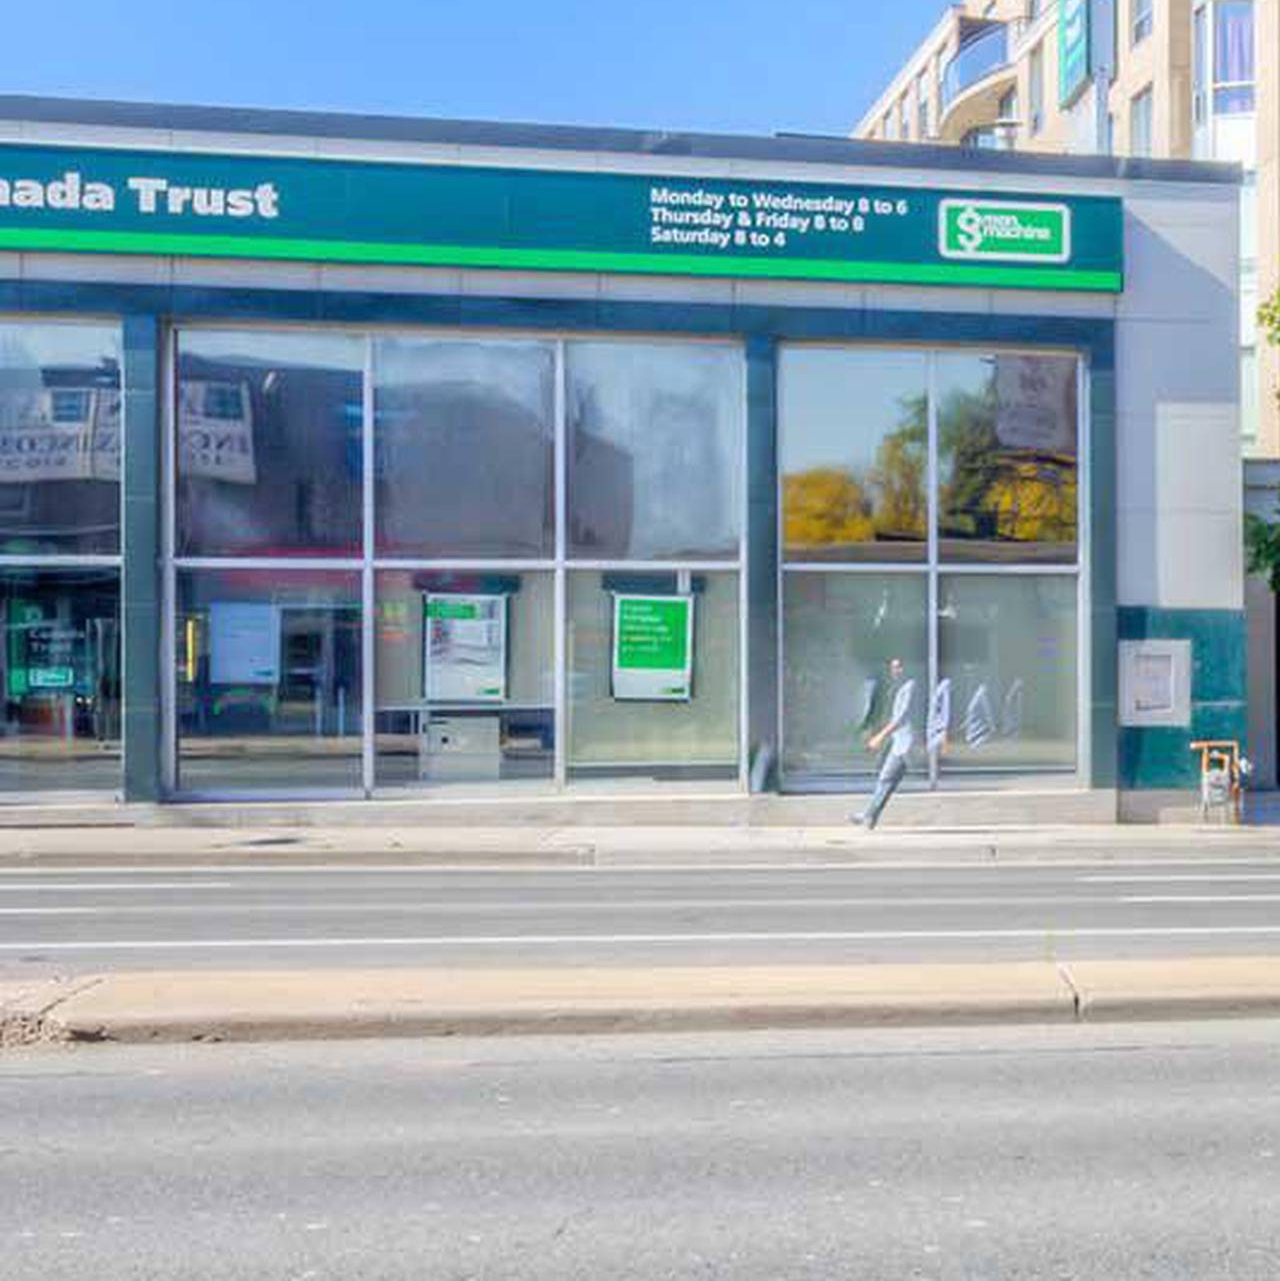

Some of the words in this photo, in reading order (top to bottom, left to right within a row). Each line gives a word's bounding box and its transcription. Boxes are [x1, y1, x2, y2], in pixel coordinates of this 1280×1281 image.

[128, 177, 279, 217] Trust
[651, 188, 724, 210] Monday
[728, 193, 748, 207] to
[752, 192, 854, 216] Wednesday
[873, 199, 893, 214] to
[896, 199, 908, 215] 6
[651, 207, 734, 230] Thursday
[737, 210, 752, 226] &
[755, 211, 811, 233] Friday
[829, 216, 850, 231] to
[651, 226, 731, 248] Saturday
[749, 232, 769, 246] to
[773, 231, 786, 247] 4
